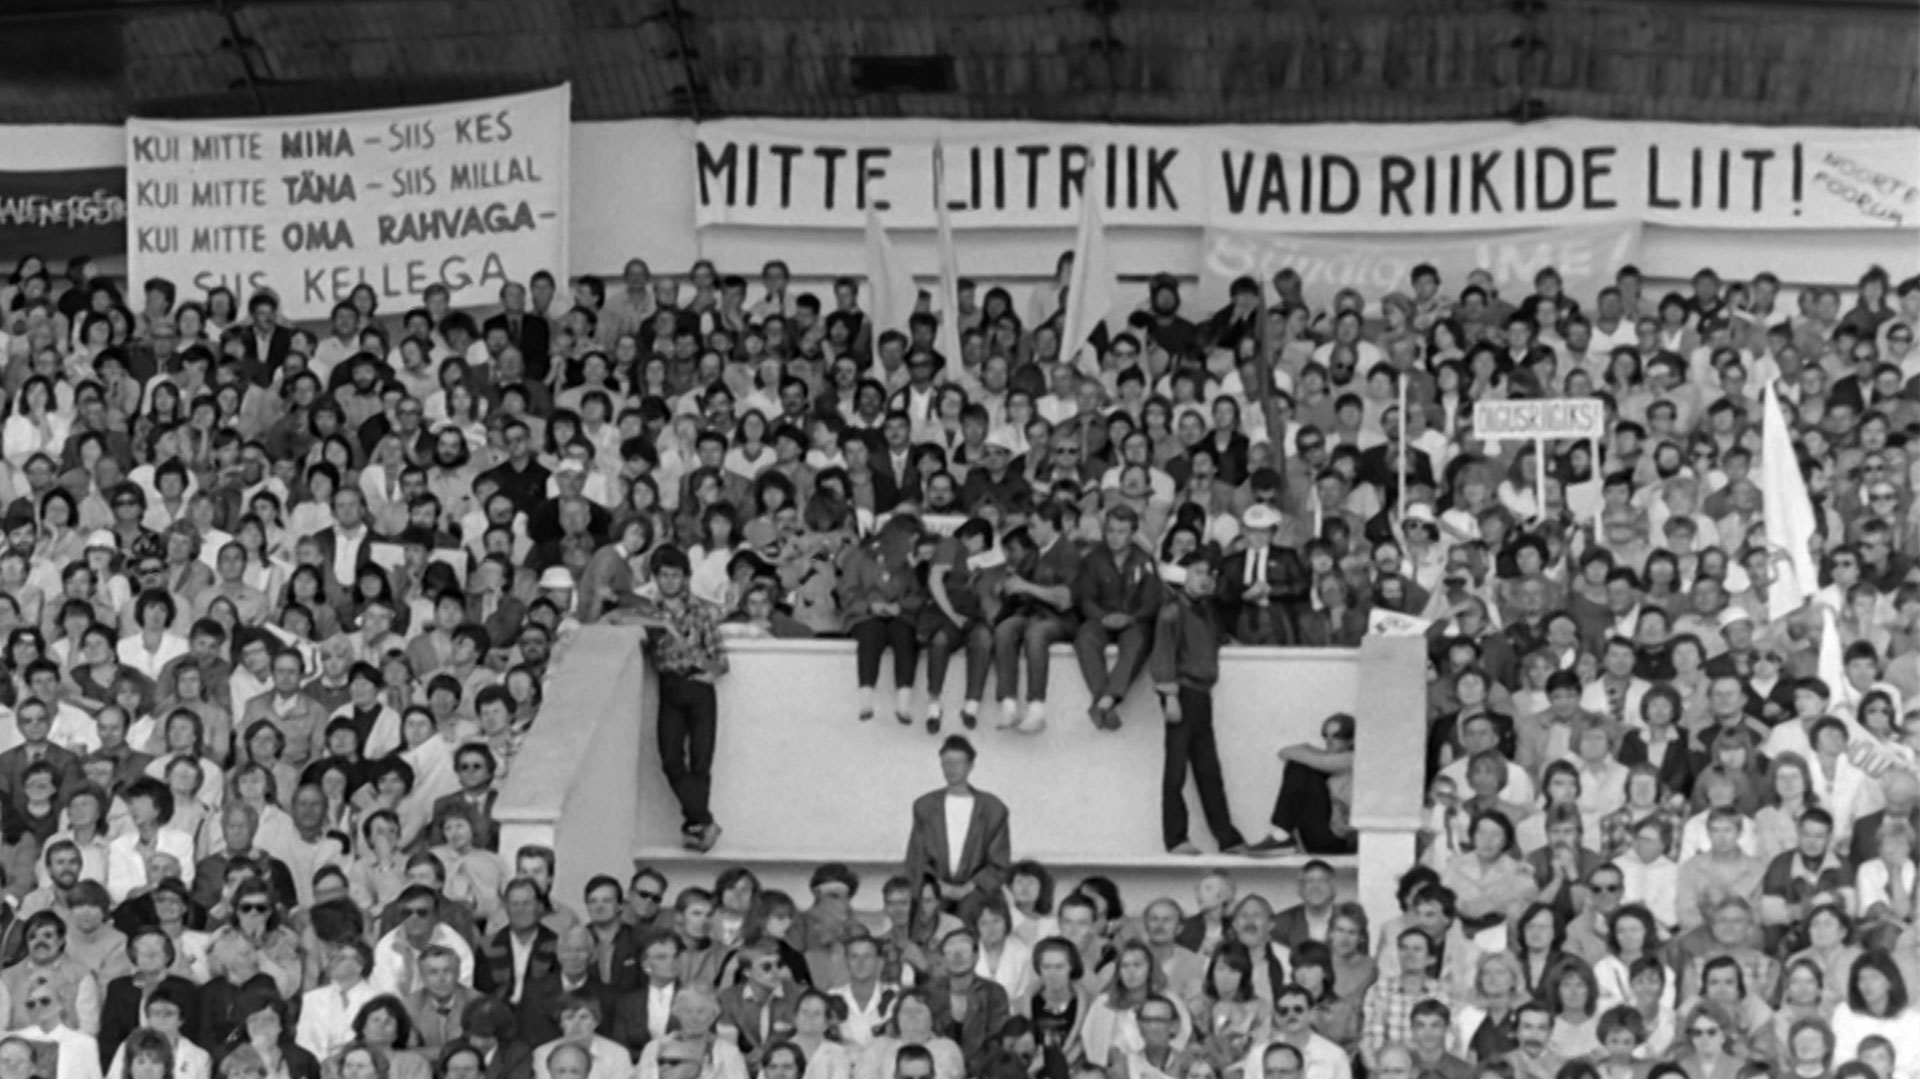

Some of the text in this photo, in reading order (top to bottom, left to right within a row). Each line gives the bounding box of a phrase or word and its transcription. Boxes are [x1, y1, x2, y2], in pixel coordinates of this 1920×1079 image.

[133, 135, 179, 162] KUI
[192, 131, 262, 162] MITTE
[281, 127, 355, 159] MINA
[389, 119, 435, 152] SIIS
[455, 109, 513, 144] KES
[136, 179, 180, 209] KUI
[192, 177, 267, 207] MITTE
[281, 169, 358, 206] TÄNA
[392, 165, 437, 198] SIIS
[450, 155, 543, 192] MILLAL
[696, 141, 892, 211] MITTE
[1220, 149, 1360, 216] VAID
[1380, 147, 1617, 216] RIIKIDE
[1647, 142, 1803, 217] LIIT!
[137, 226, 179, 253] KUI
[191, 224, 266, 253] MITTE
[282, 217, 355, 252] OMA
